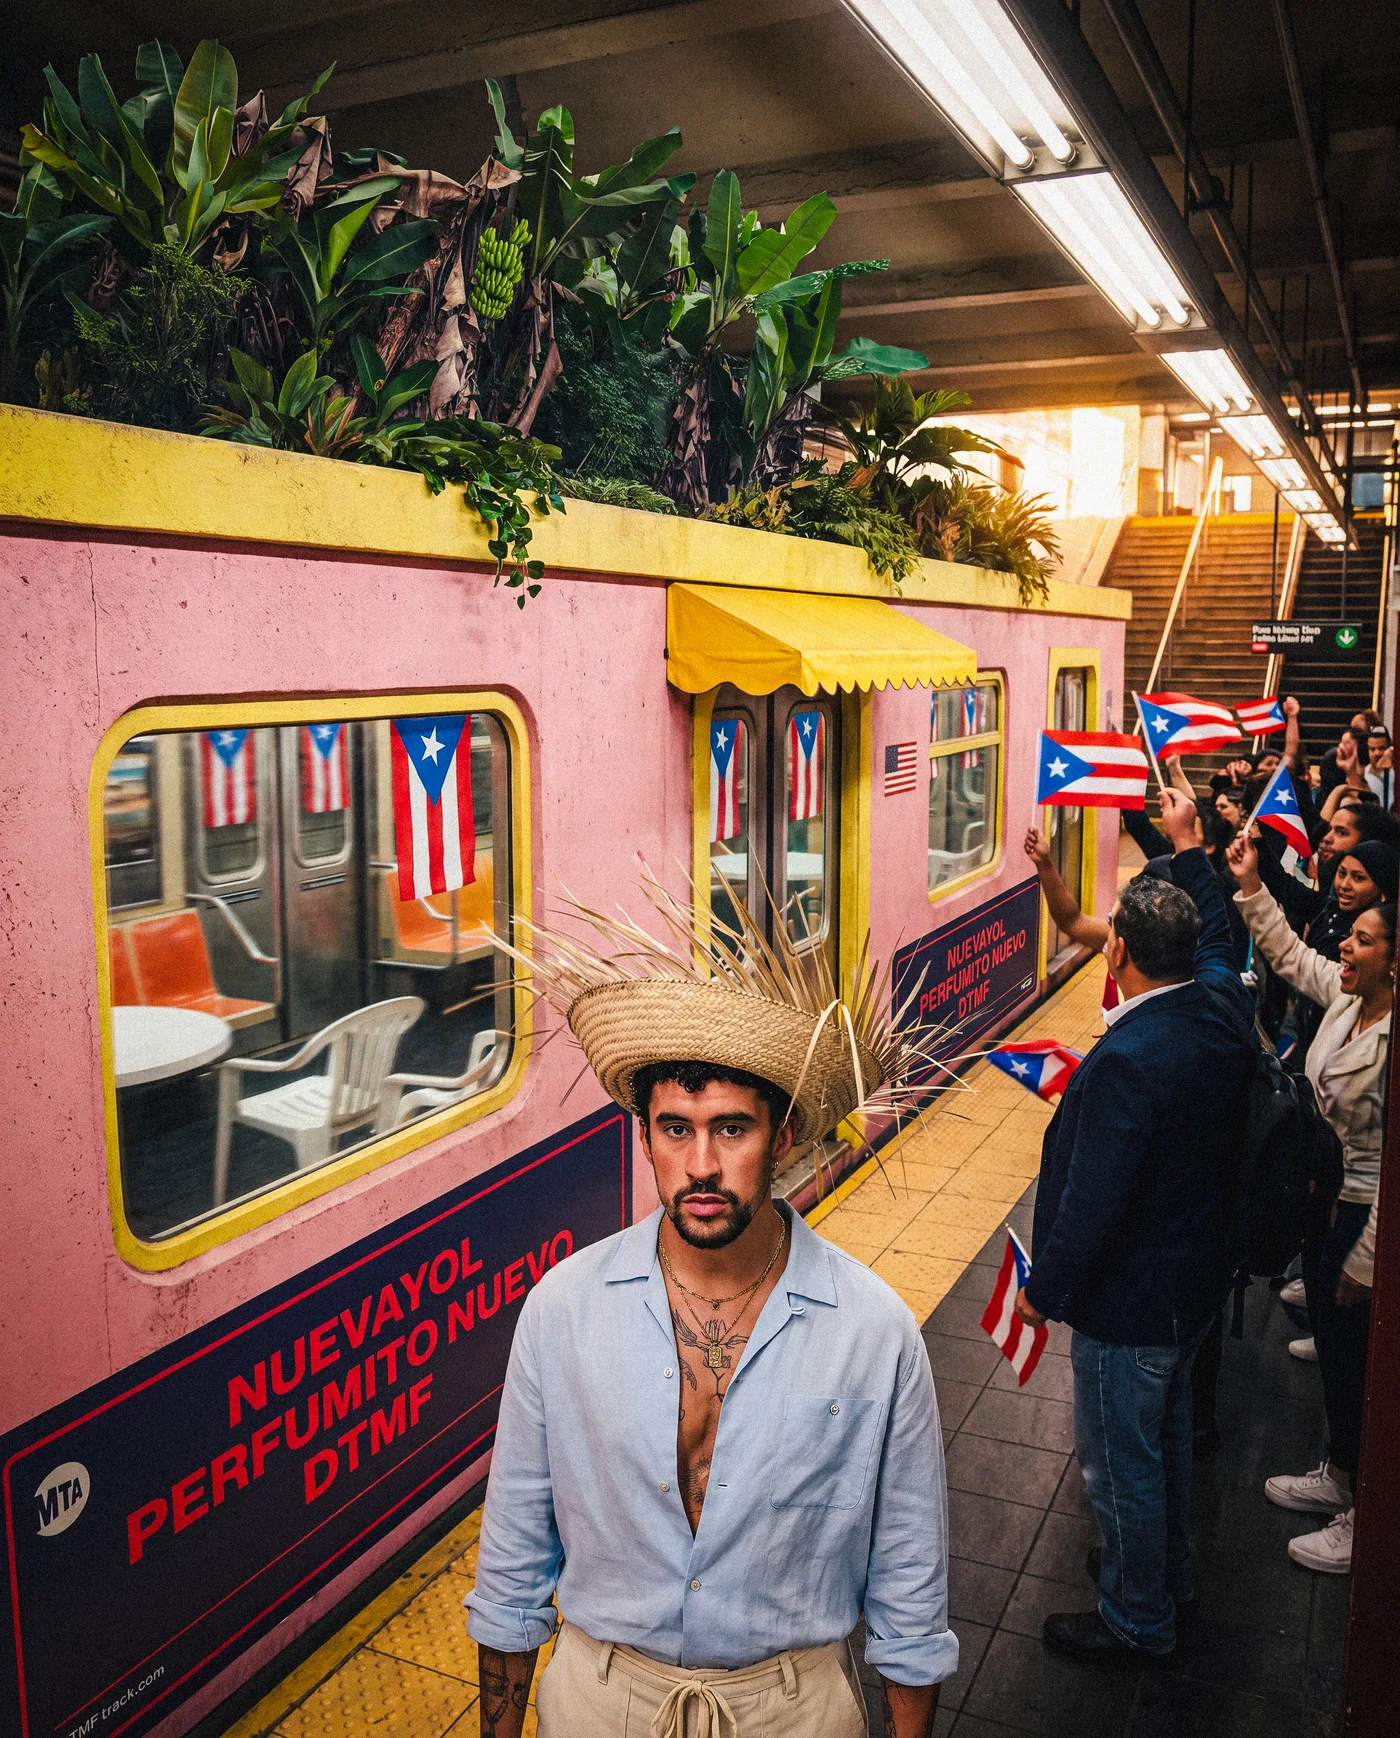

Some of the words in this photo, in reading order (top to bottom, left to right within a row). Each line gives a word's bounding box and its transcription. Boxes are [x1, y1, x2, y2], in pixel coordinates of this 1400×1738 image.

[920, 953, 990, 1019] PERFUMITO
[992, 929, 1027, 968] NUEVO
[947, 919, 1006, 971] NUEVAYOL
[958, 979, 991, 1019] DTMF
[228, 1238, 483, 1427] NUEVAYOL
[128, 1320, 438, 1564] PERFUMITO
[447, 1230, 574, 1344] NUEVO
[304, 1373, 434, 1504] DTMF
[35, 1475, 85, 1534] MTA
[65, 1713, 99, 1738] TMF
[102, 1666, 165, 1720] track.com
